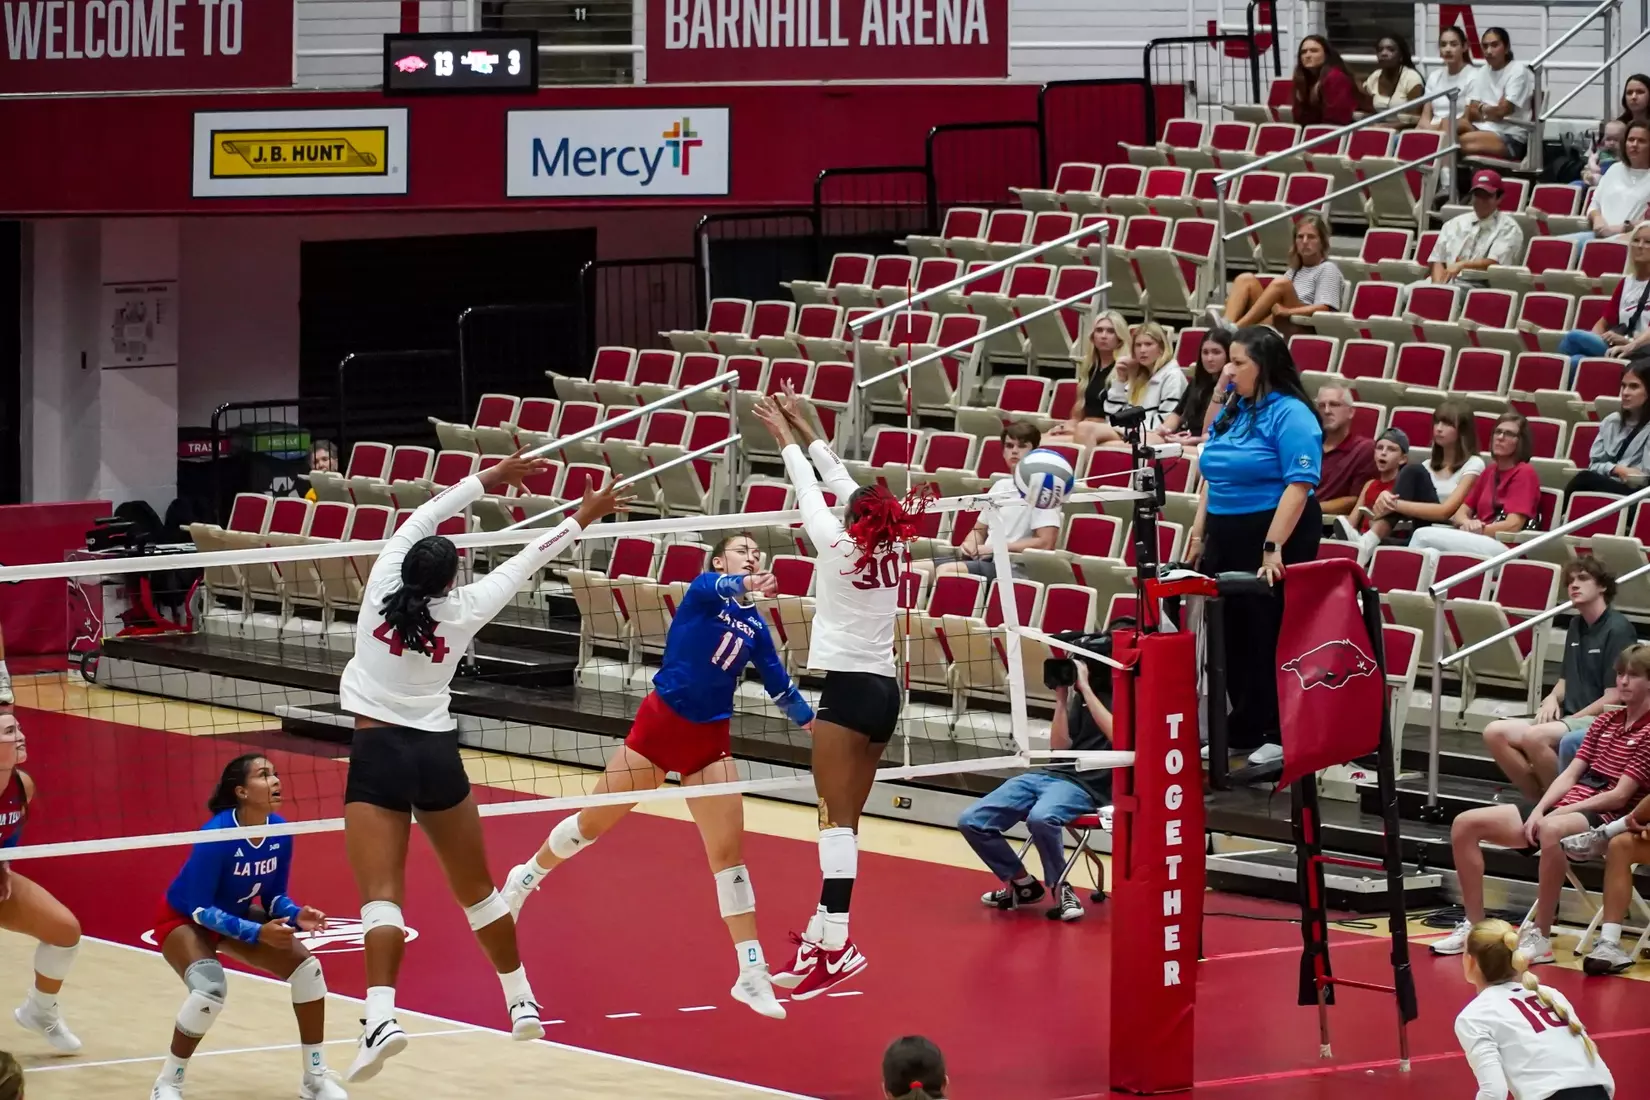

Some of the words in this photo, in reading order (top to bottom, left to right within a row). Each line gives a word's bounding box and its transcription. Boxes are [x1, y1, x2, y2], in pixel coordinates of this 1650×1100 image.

[4, 0, 186, 59] WELCOME
[198, 0, 243, 56] TO
[574, 8, 586, 21] 11
[665, 0, 849, 49] BARNHILL
[860, 0, 988, 46] ARENA
[433, 51, 453, 76] 13
[508, 49, 520, 75] 3
[292, 144, 345, 162] HUNT
[532, 137, 665, 186] Mercy
[852, 552, 899, 590] 30
[711, 631, 744, 671] 11
[233, 862, 250, 876] LA
[254, 856, 277, 876] TECH
[1163, 713, 1184, 986] TOGETHER
[1508, 994, 1570, 1034] 18
